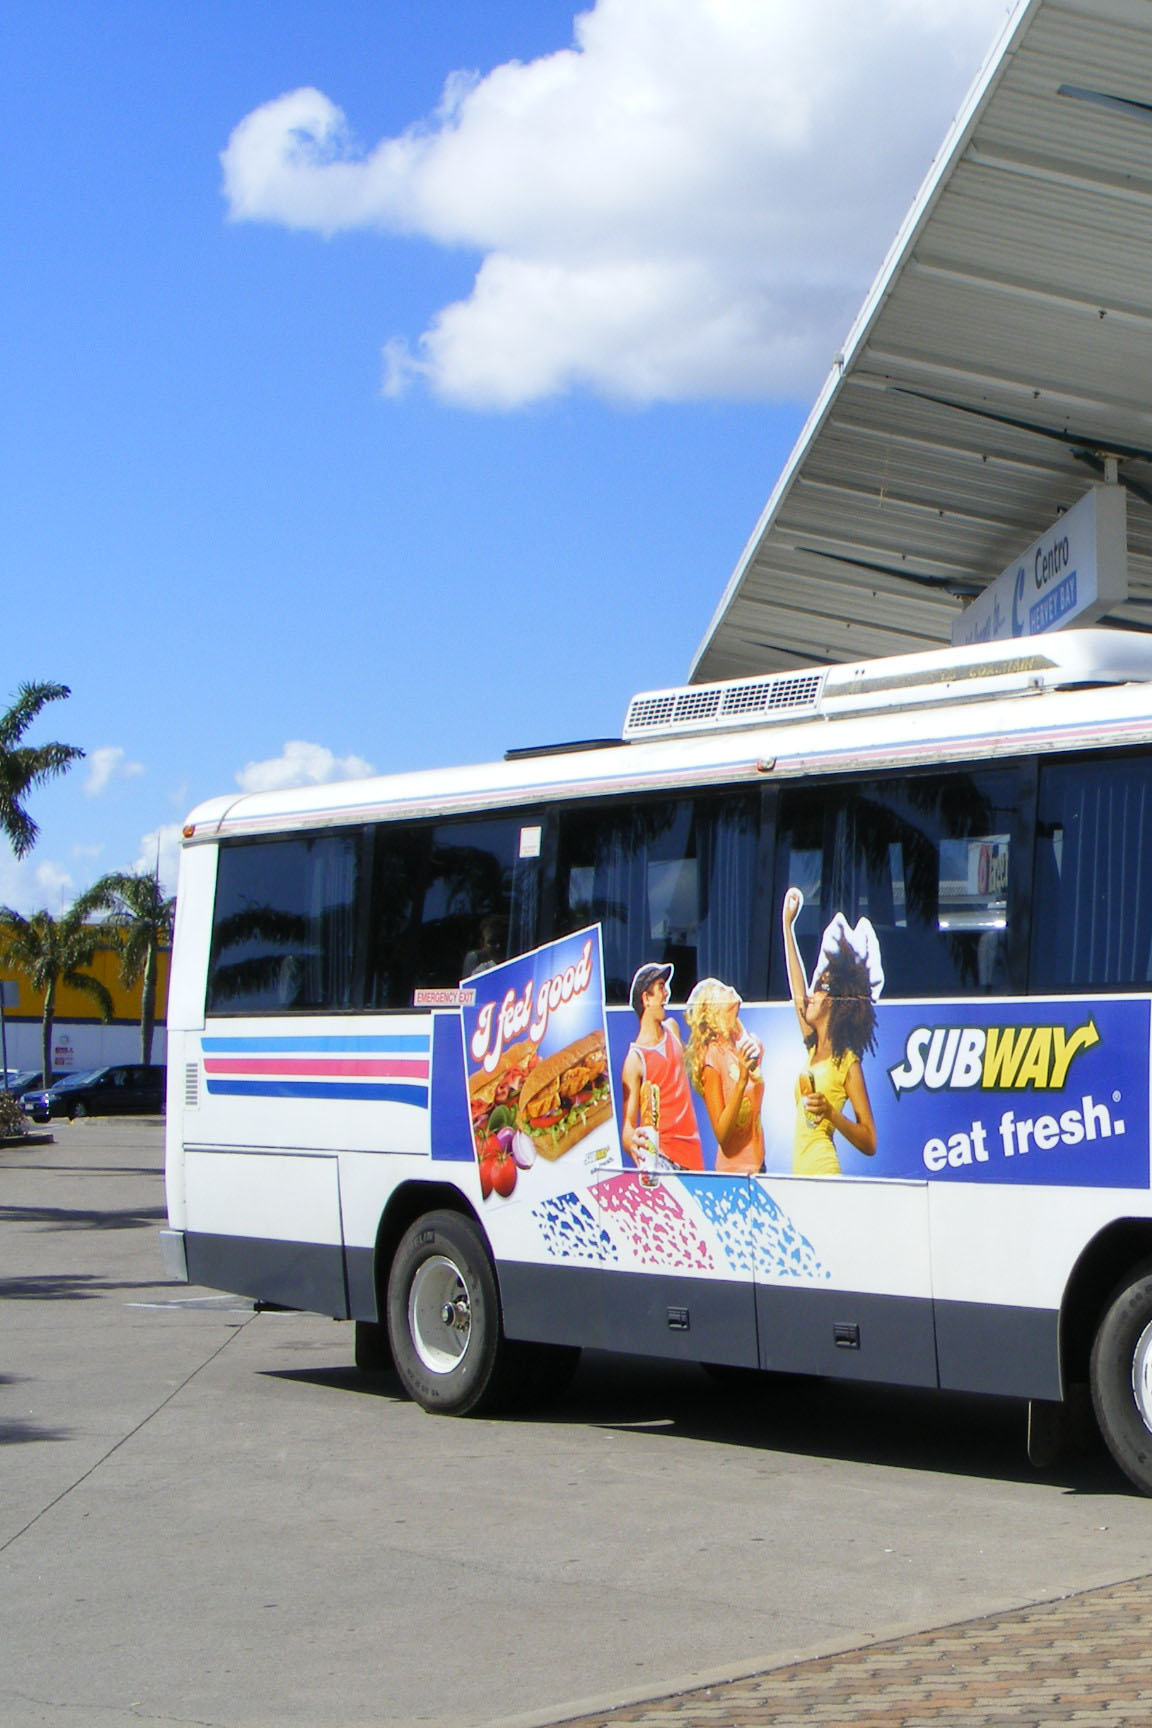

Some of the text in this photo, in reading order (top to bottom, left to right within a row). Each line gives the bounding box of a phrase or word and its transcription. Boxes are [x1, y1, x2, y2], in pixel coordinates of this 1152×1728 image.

[1034, 536, 1069, 589] Centro
[417, 991, 474, 1003] EMERGENCY EXIT
[471, 939, 593, 1073] I feel good
[889, 1016, 1101, 1095] SUBWAY
[922, 1095, 1126, 1172] eat fresh.
